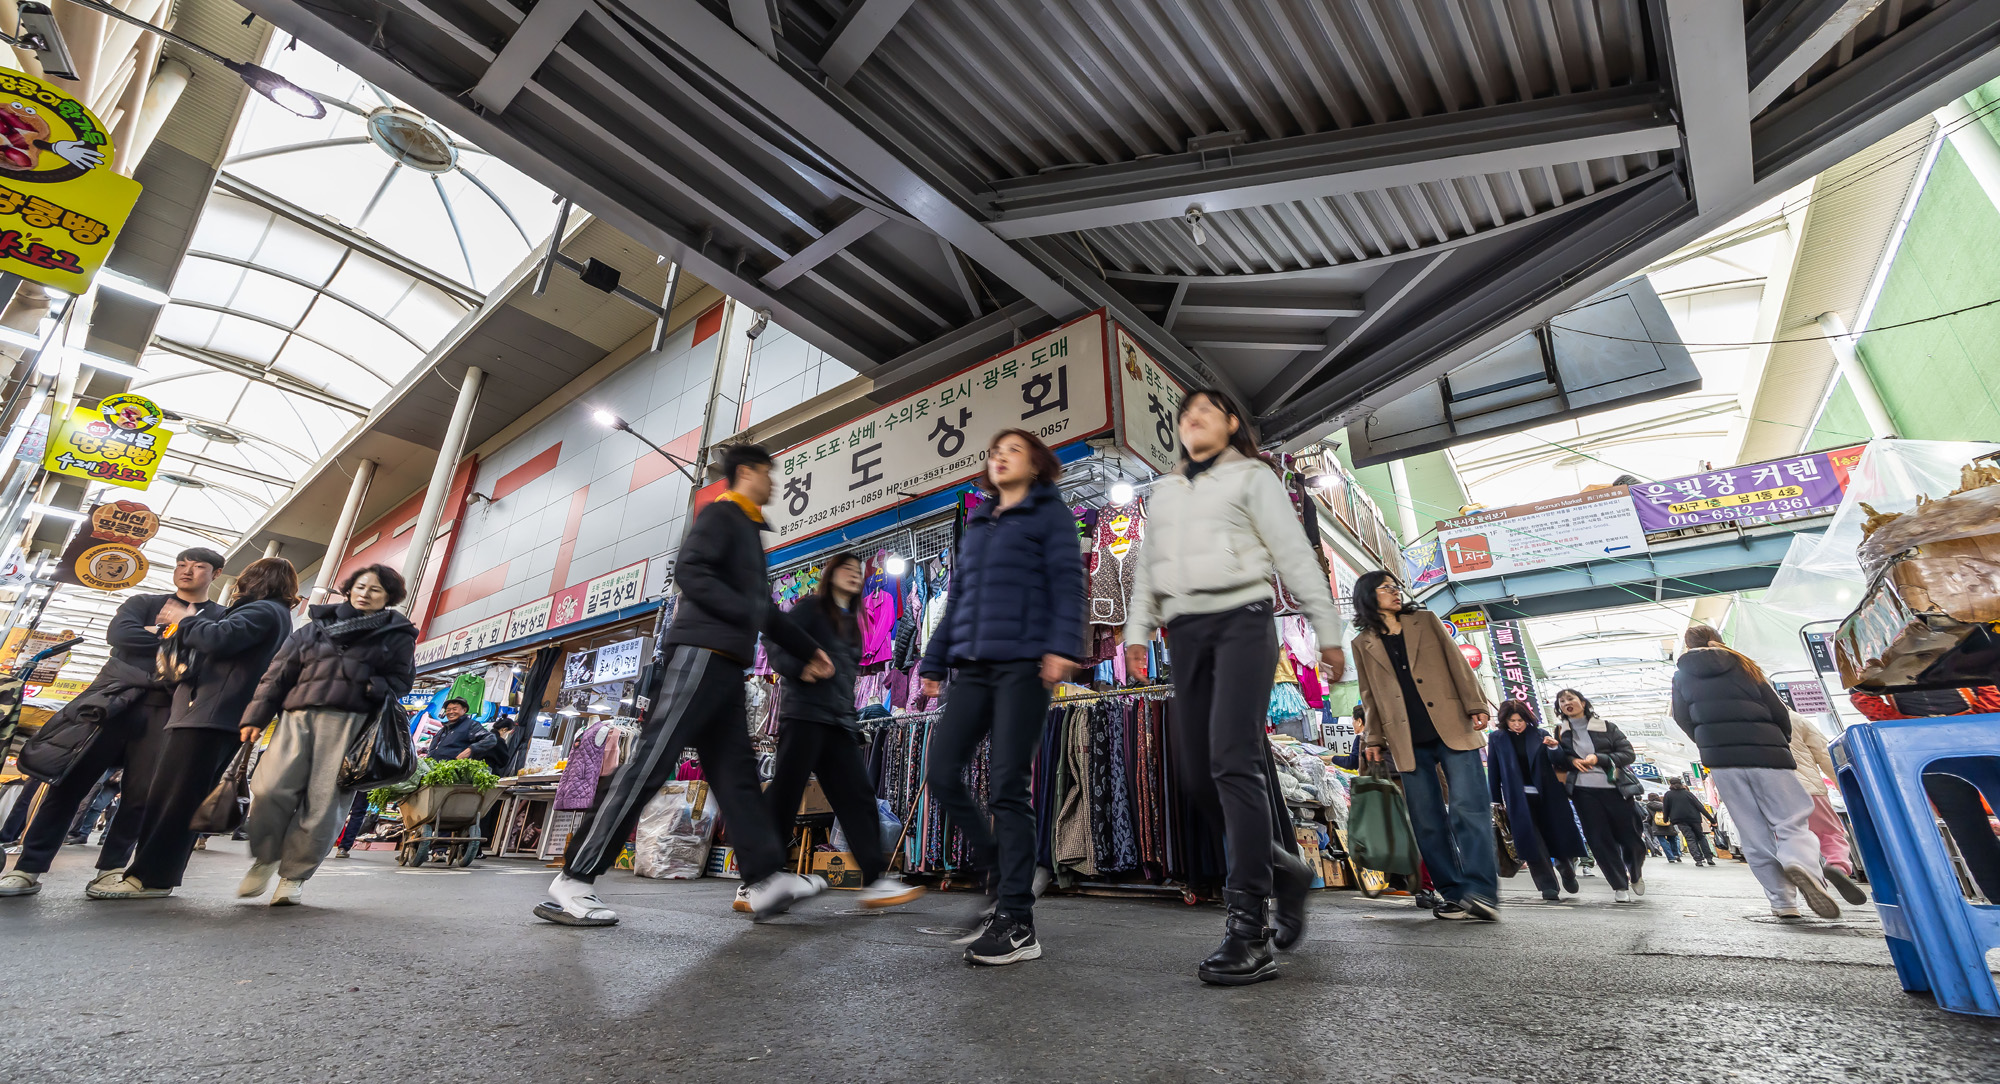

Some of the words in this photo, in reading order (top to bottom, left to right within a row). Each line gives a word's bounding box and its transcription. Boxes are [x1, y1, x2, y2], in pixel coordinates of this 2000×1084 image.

[71, 431, 157, 466] 땅콩빵
[111, 428, 156, 449] 서문
[1645, 471, 1737, 505] 은빛창
[1751, 457, 1822, 487] 커텐
[1534, 502, 1560, 512] Seomun
[1560, 497, 1582, 507] Market
[1668, 496, 1813, 526] 010-6512-4361
[1672, 501, 1700, 512] 1지구
[1738, 494, 1750, 504] 남
[1754, 490, 1773, 500] 1동
[1778, 486, 1798, 497] 4호
[98, 518, 149, 538] 땅콩빵
[111, 510, 147, 526] 대신
[587, 580, 637, 614] 길곡상회
